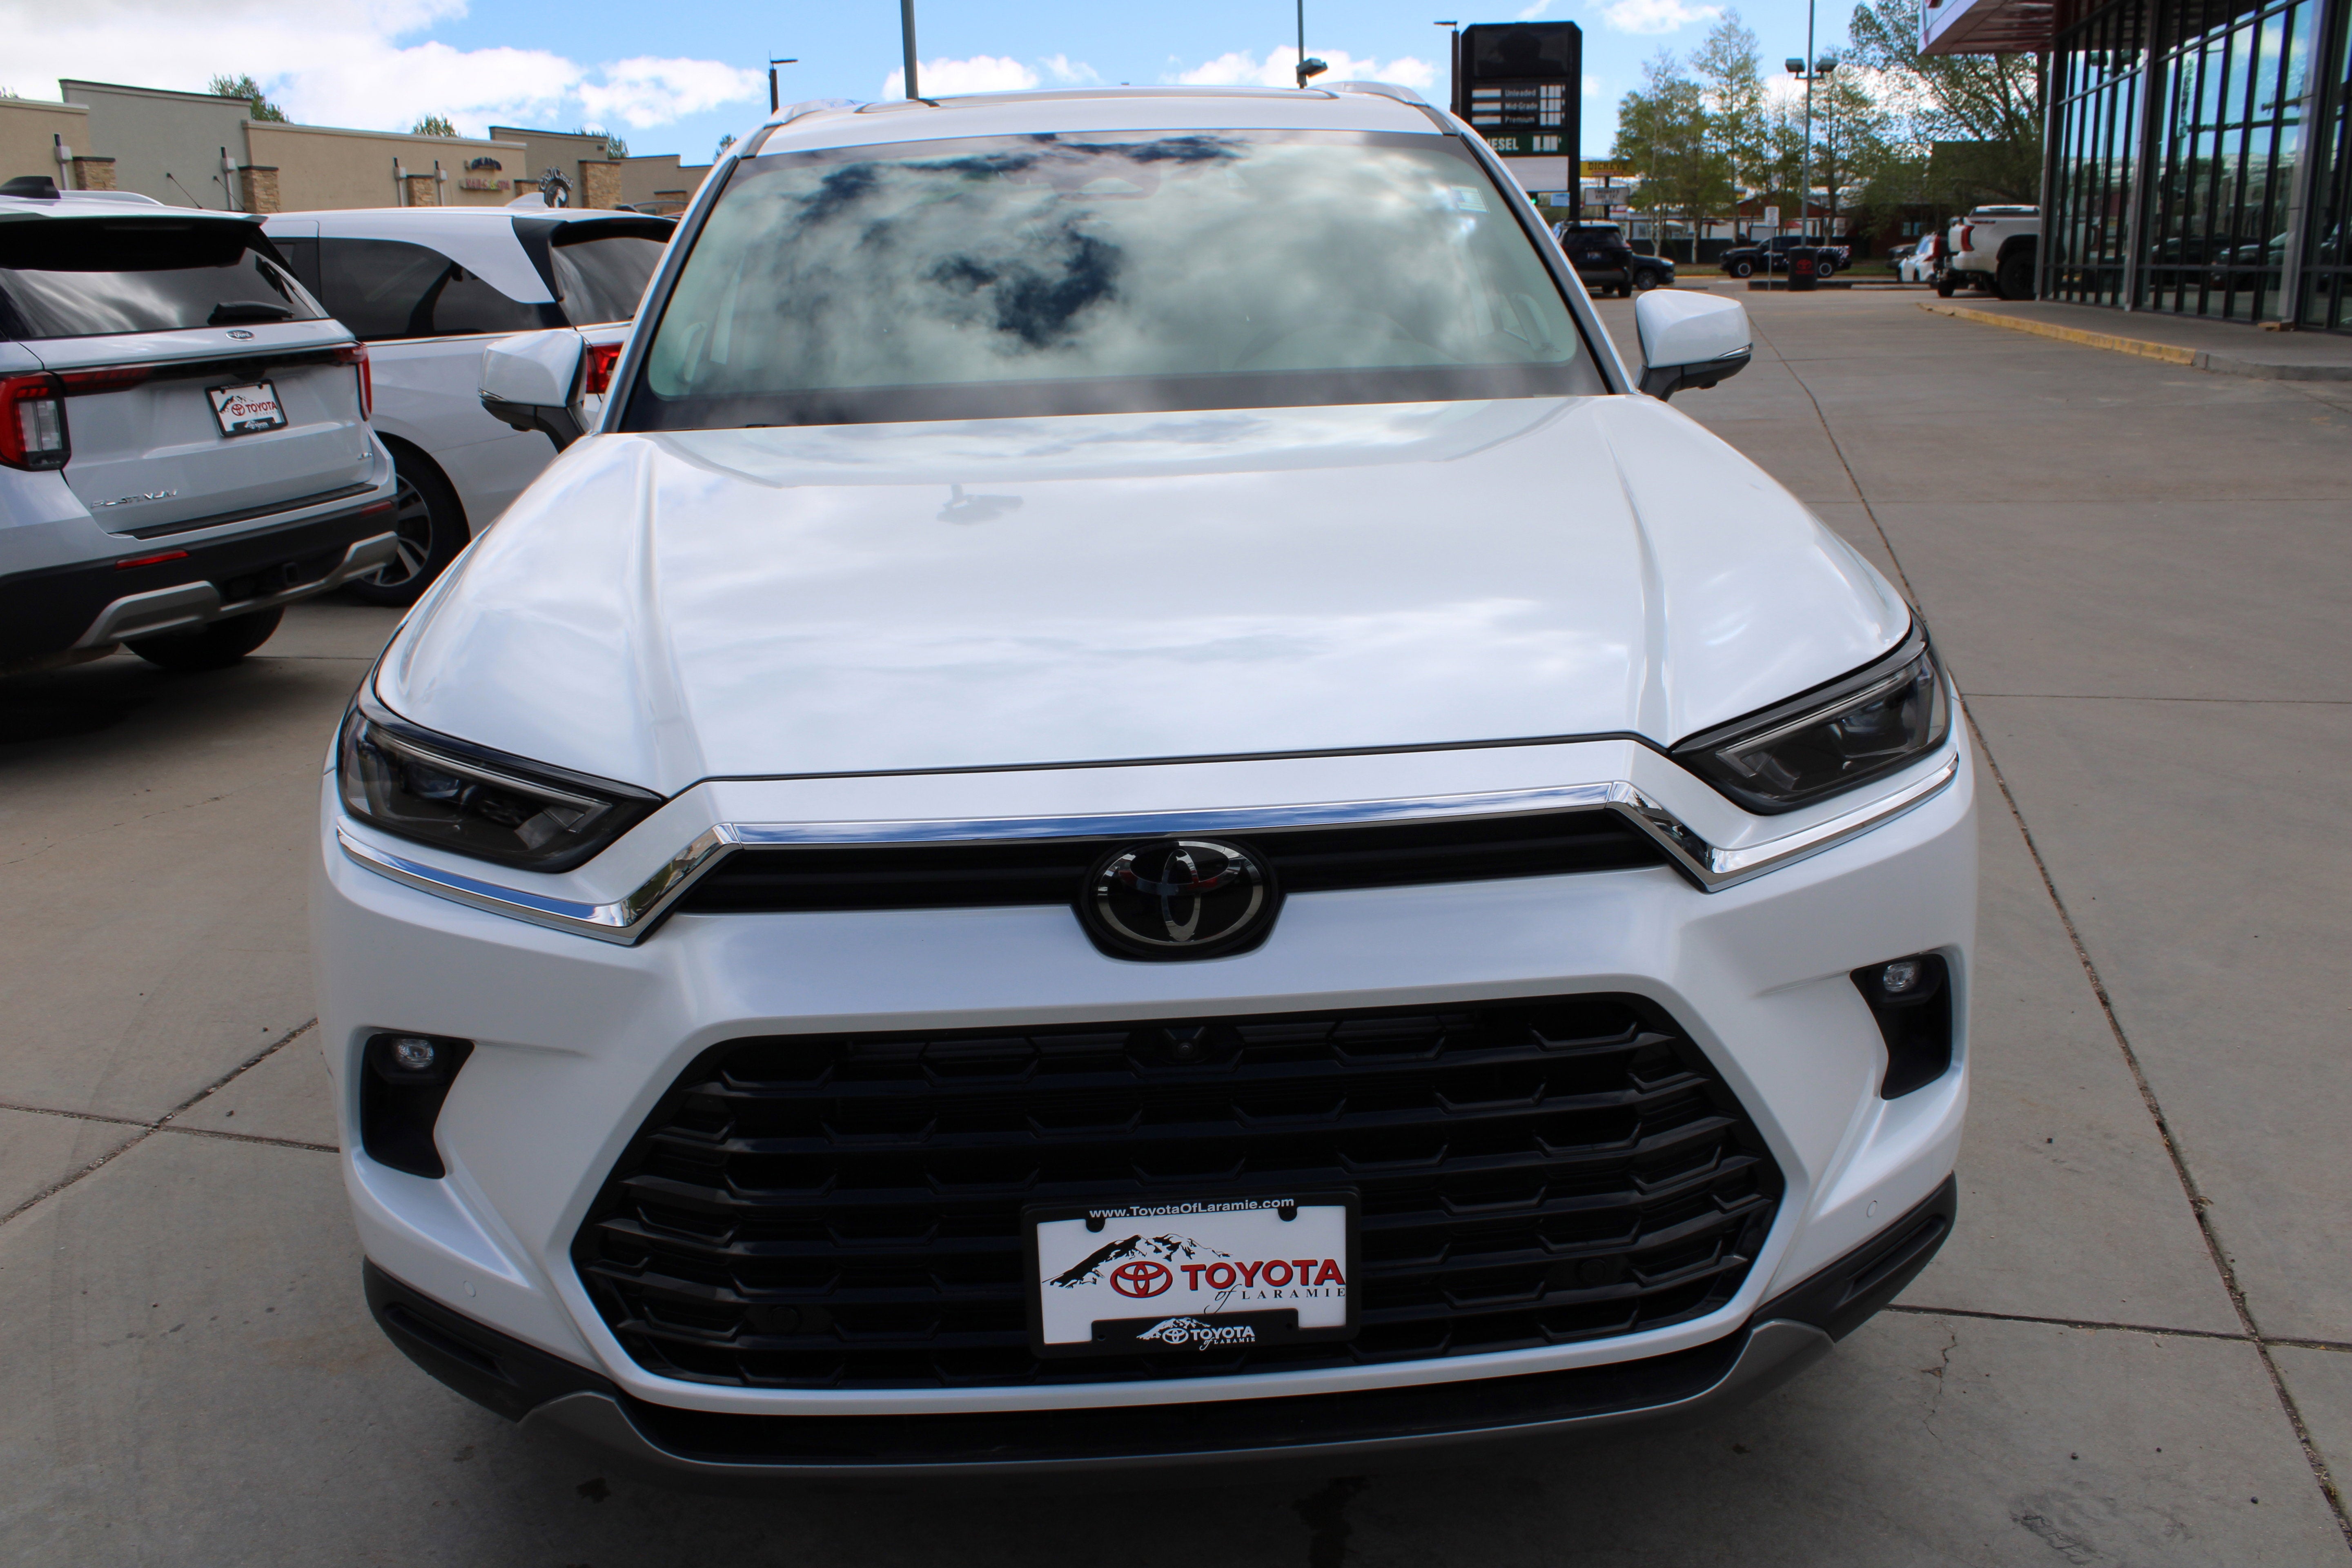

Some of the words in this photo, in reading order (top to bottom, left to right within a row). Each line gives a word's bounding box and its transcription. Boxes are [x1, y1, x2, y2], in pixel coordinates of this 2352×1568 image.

[1505, 88, 1536, 97] Unleaded
[1505, 102, 1538, 110] Mid-Grade
[1487, 137, 1519, 151] IESEL
[465, 178, 488, 189] NAILS
[540, 167, 554, 190] Coal
[245, 401, 278, 413] TOYOTA
[90, 489, 178, 508] PLATINUM
[1089, 1198, 1294, 1218] www.ToyotaOfLaramie.com
[1180, 1259, 1346, 1291] TOYOTA
[1203, 1283, 1242, 1314] of
[1241, 1288, 1345, 1299] LARAMIE
[1190, 1326, 1255, 1341] TOYOTA
[1199, 1336, 1215, 1351] of
